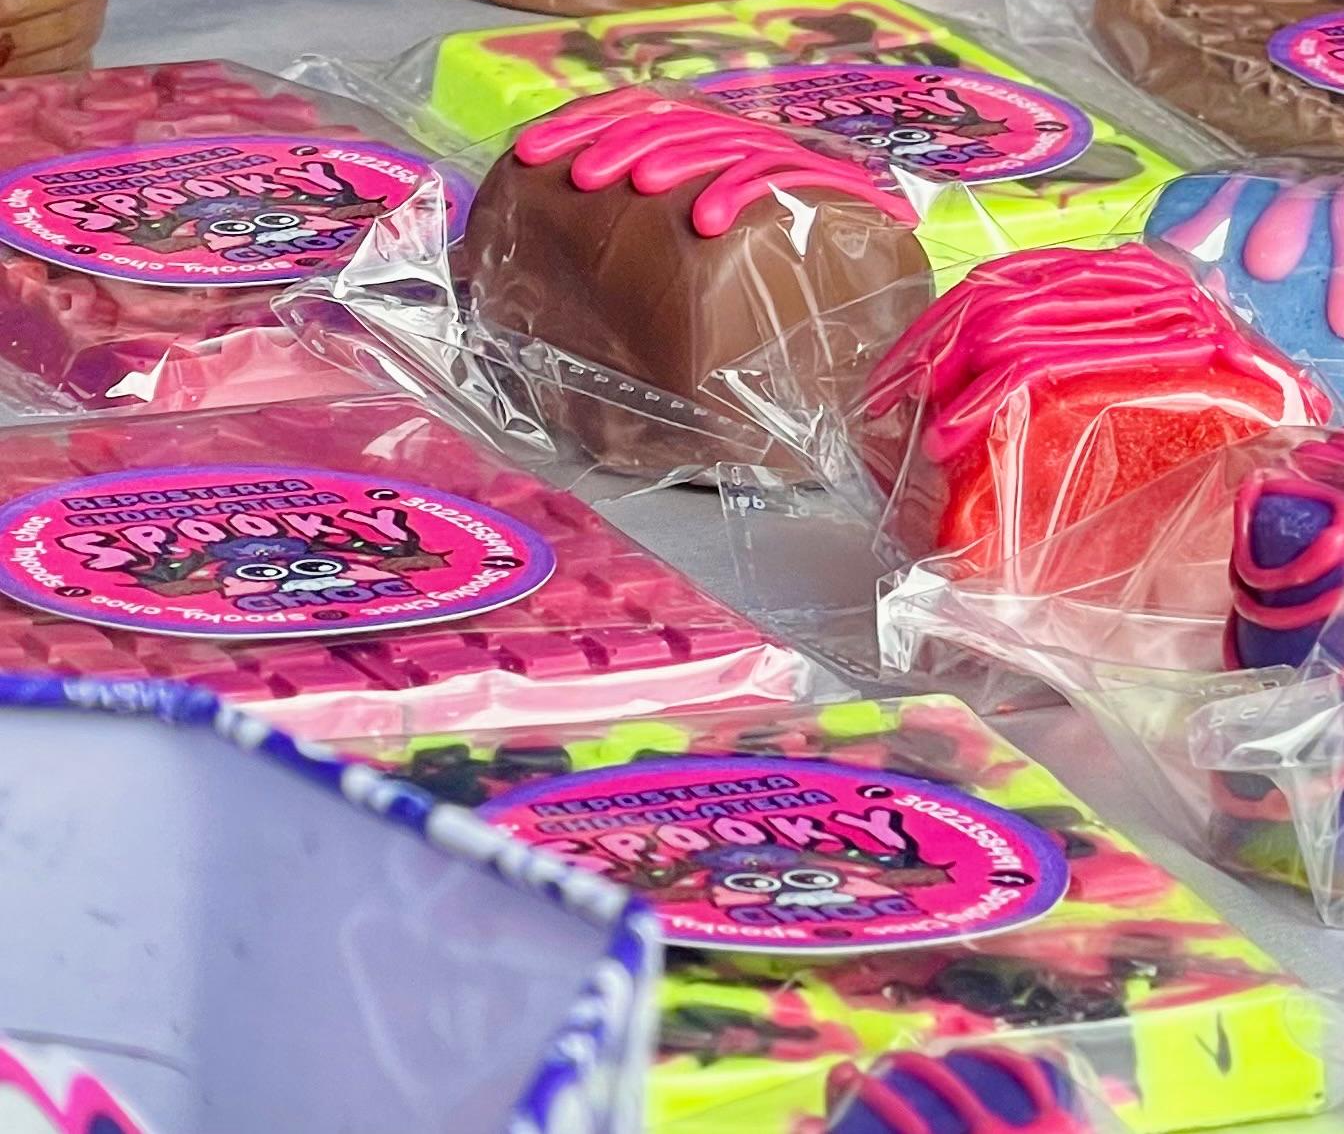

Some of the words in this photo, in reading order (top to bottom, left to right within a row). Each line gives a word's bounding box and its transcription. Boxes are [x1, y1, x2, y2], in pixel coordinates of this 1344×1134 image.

[741, 88, 967, 126] POOKY
[44, 162, 346, 232] SPOOKY
[62, 479, 313, 511] REPOSTERIA
[55, 509, 412, 571] SPOOKY
[400, 496, 515, 556] 3022358491
[234, 579, 422, 613] CHOC
[427, 568, 511, 602] Spooky
[360, 598, 440, 616] Choc
[530, 775, 799, 820] REPOSTERIA
[893, 794, 1023, 870] 3022358491
[726, 896, 926, 928] CHOC
